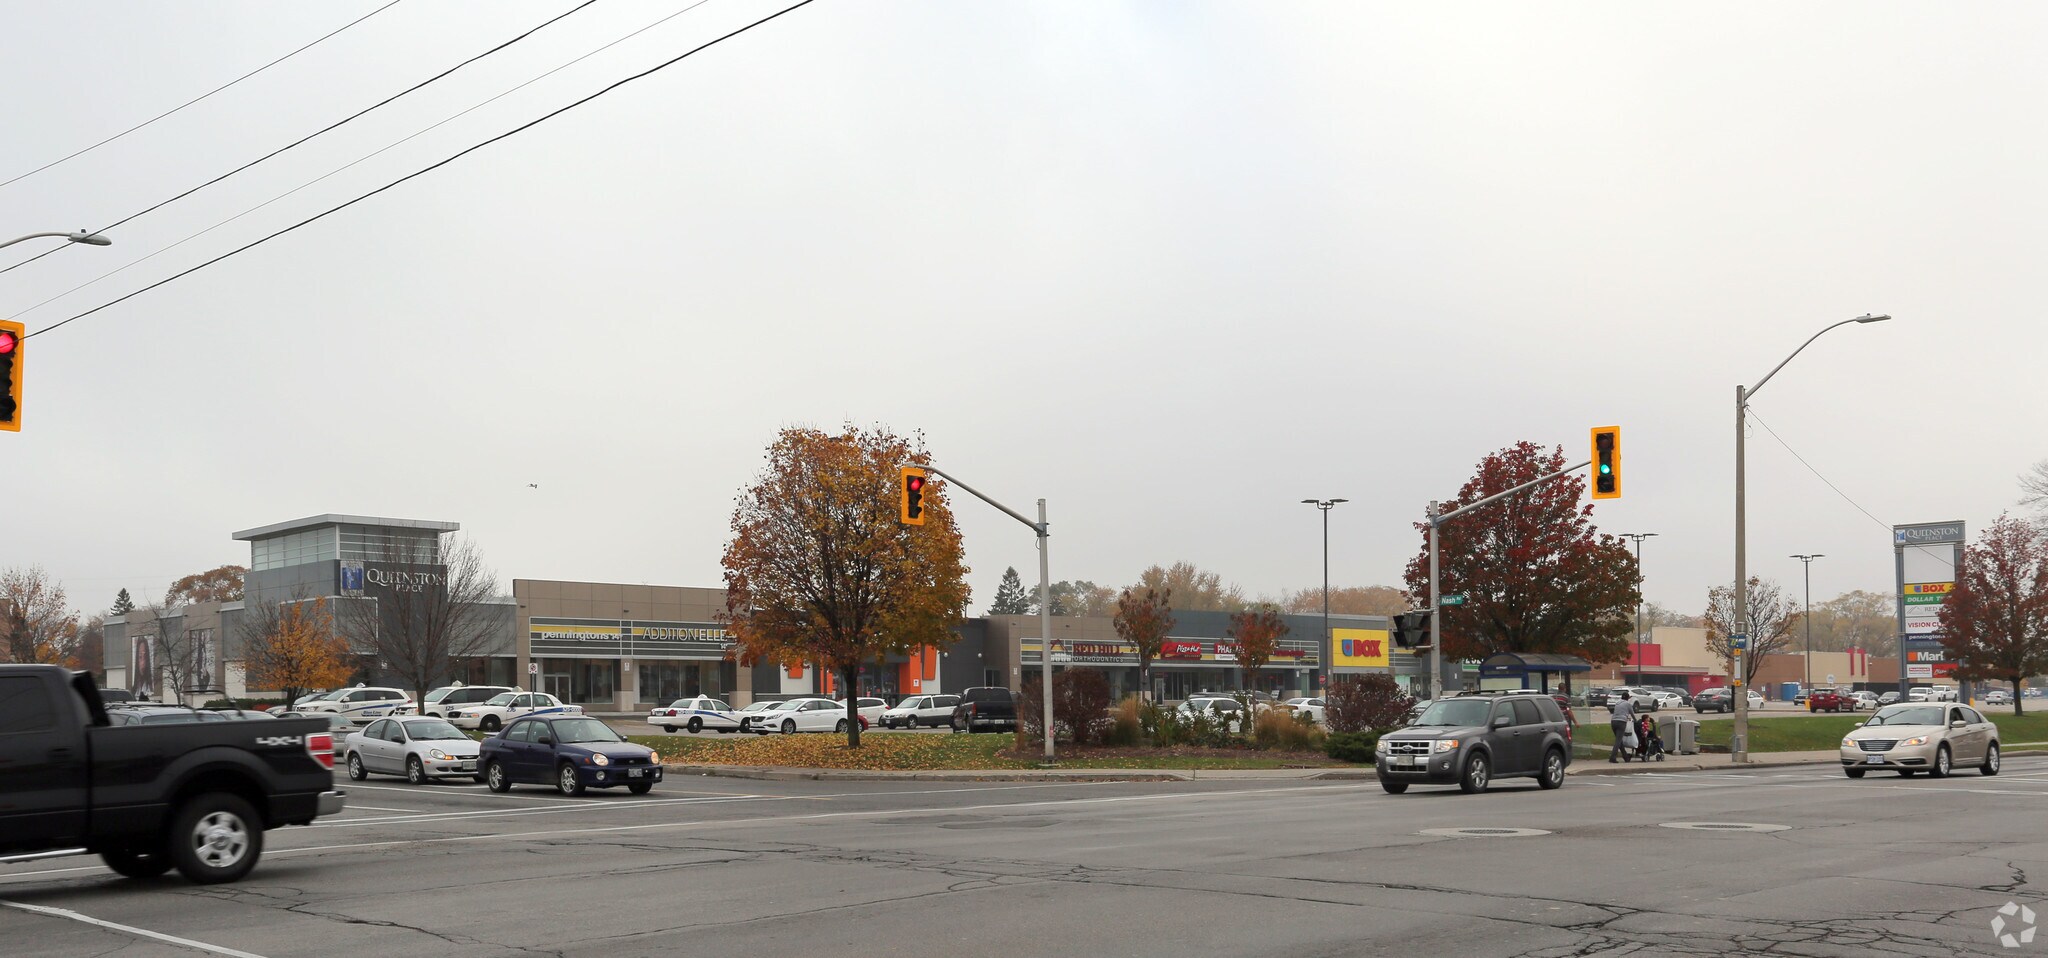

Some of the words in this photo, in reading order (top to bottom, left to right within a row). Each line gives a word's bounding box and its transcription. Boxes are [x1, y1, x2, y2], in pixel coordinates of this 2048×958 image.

[1906, 527, 1959, 539] QUEENSTON
[366, 568, 446, 587] QUEENSTON
[541, 630, 608, 641] penningtons
[642, 627, 698, 641] ADDITION
[698, 629, 728, 642] ELLE
